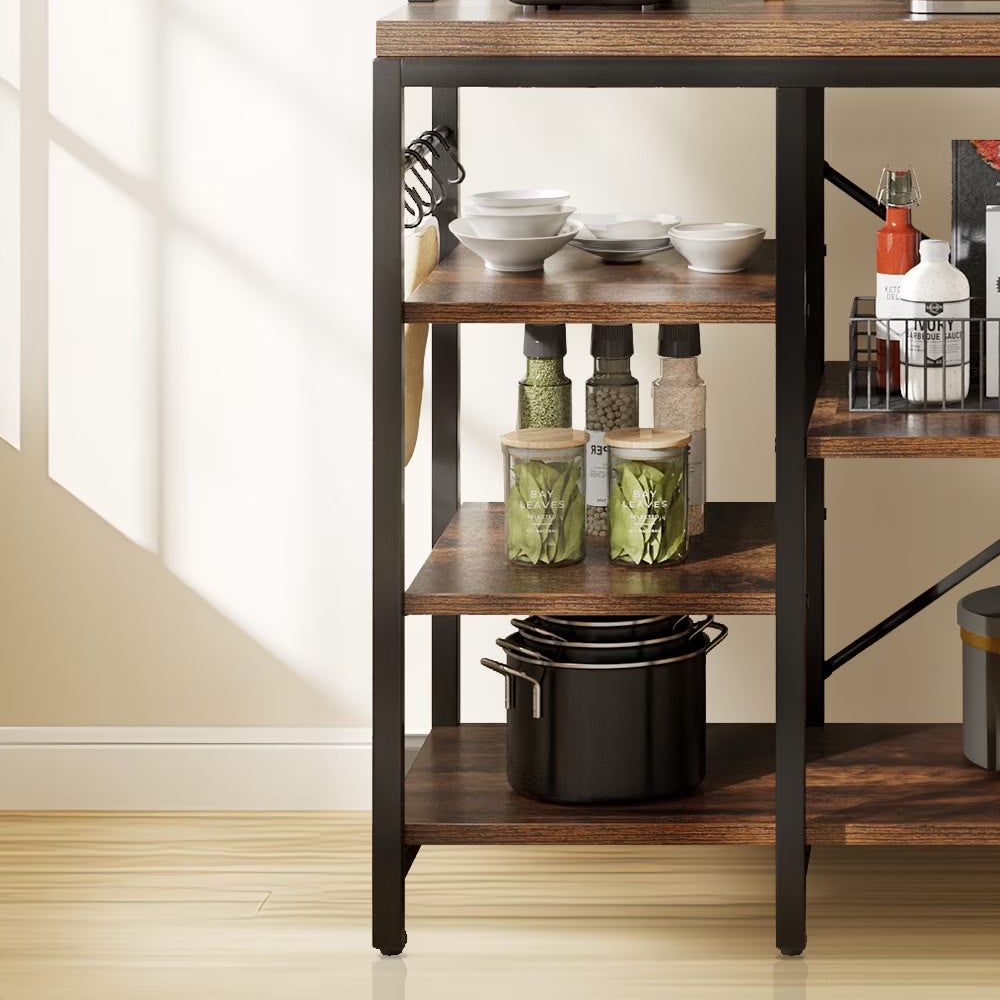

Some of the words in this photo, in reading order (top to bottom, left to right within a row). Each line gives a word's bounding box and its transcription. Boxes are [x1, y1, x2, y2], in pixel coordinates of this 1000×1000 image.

[530, 490, 553, 498] BAY
[633, 490, 656, 498] BAY
[519, 500, 565, 509] LEAVES
[623, 500, 667, 509] LEAVES
